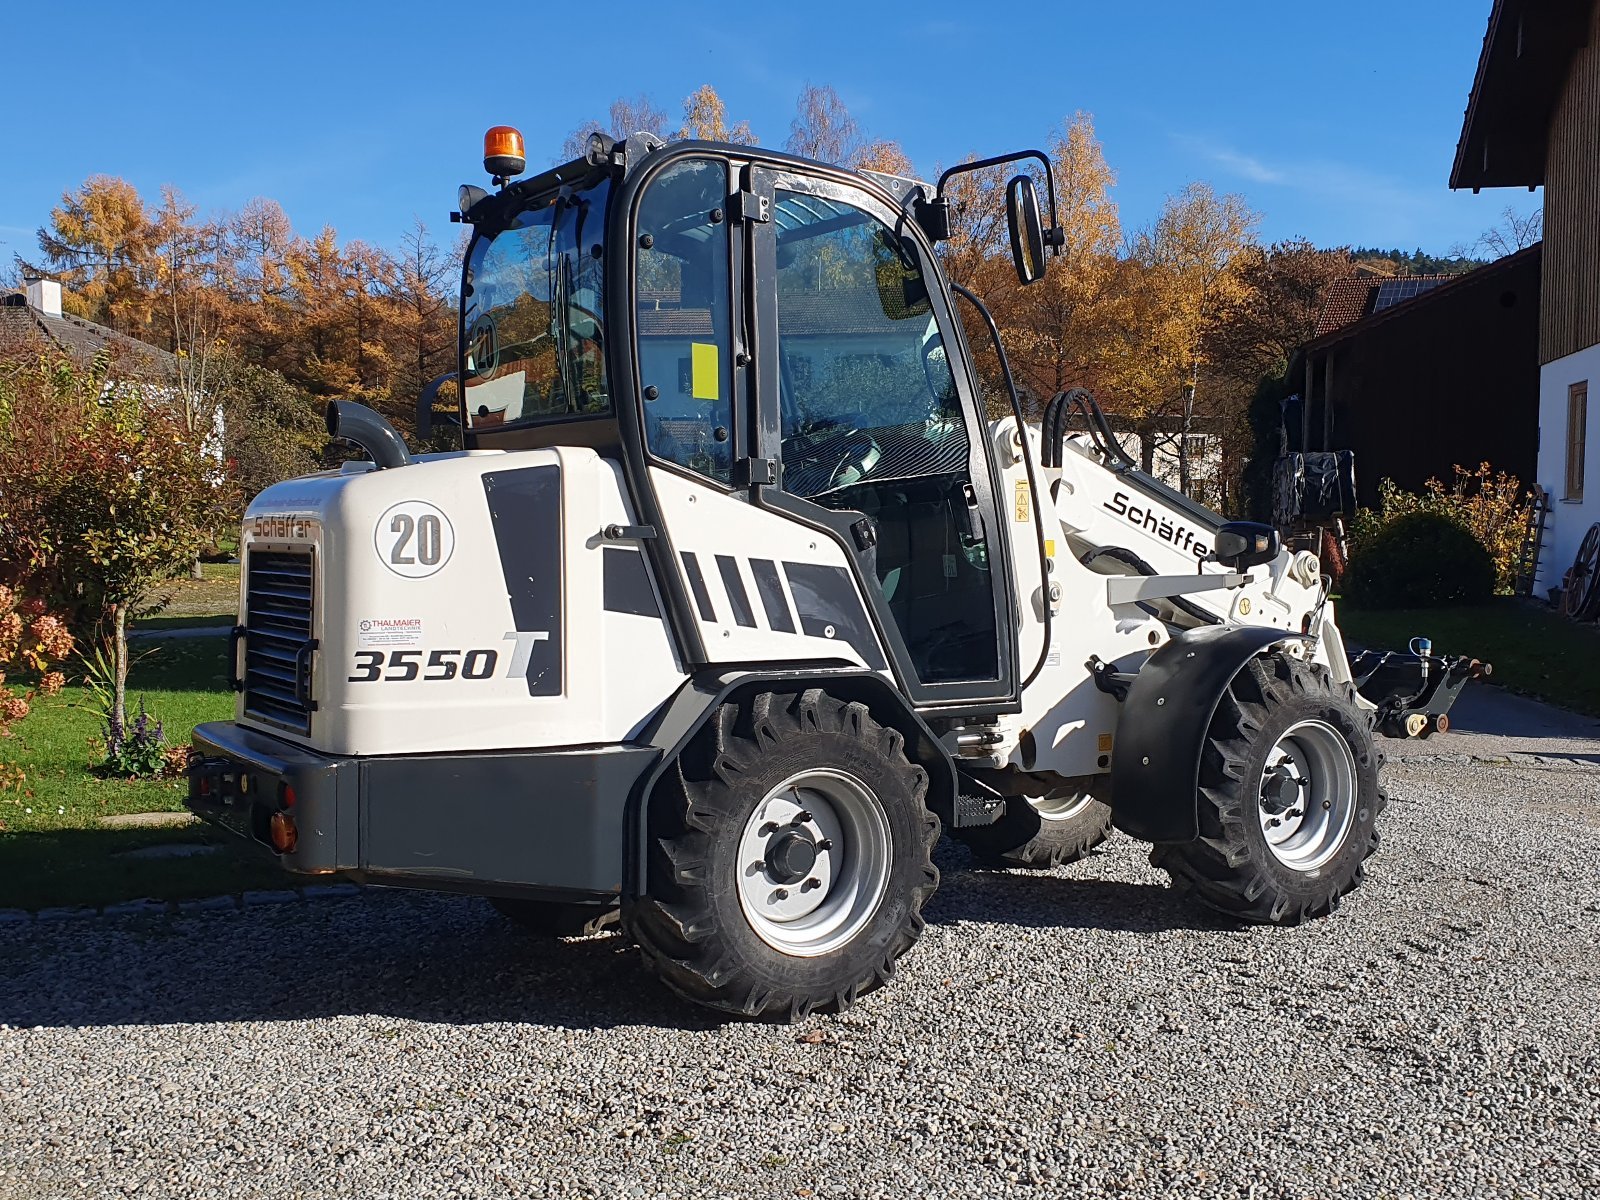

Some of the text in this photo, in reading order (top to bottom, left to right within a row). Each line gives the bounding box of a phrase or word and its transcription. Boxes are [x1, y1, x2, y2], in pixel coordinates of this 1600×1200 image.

[253, 514, 311, 538] Schäffer
[390, 513, 441, 566] 20
[1103, 492, 1216, 558] Schäffe
[372, 619, 421, 627] THALMAIER
